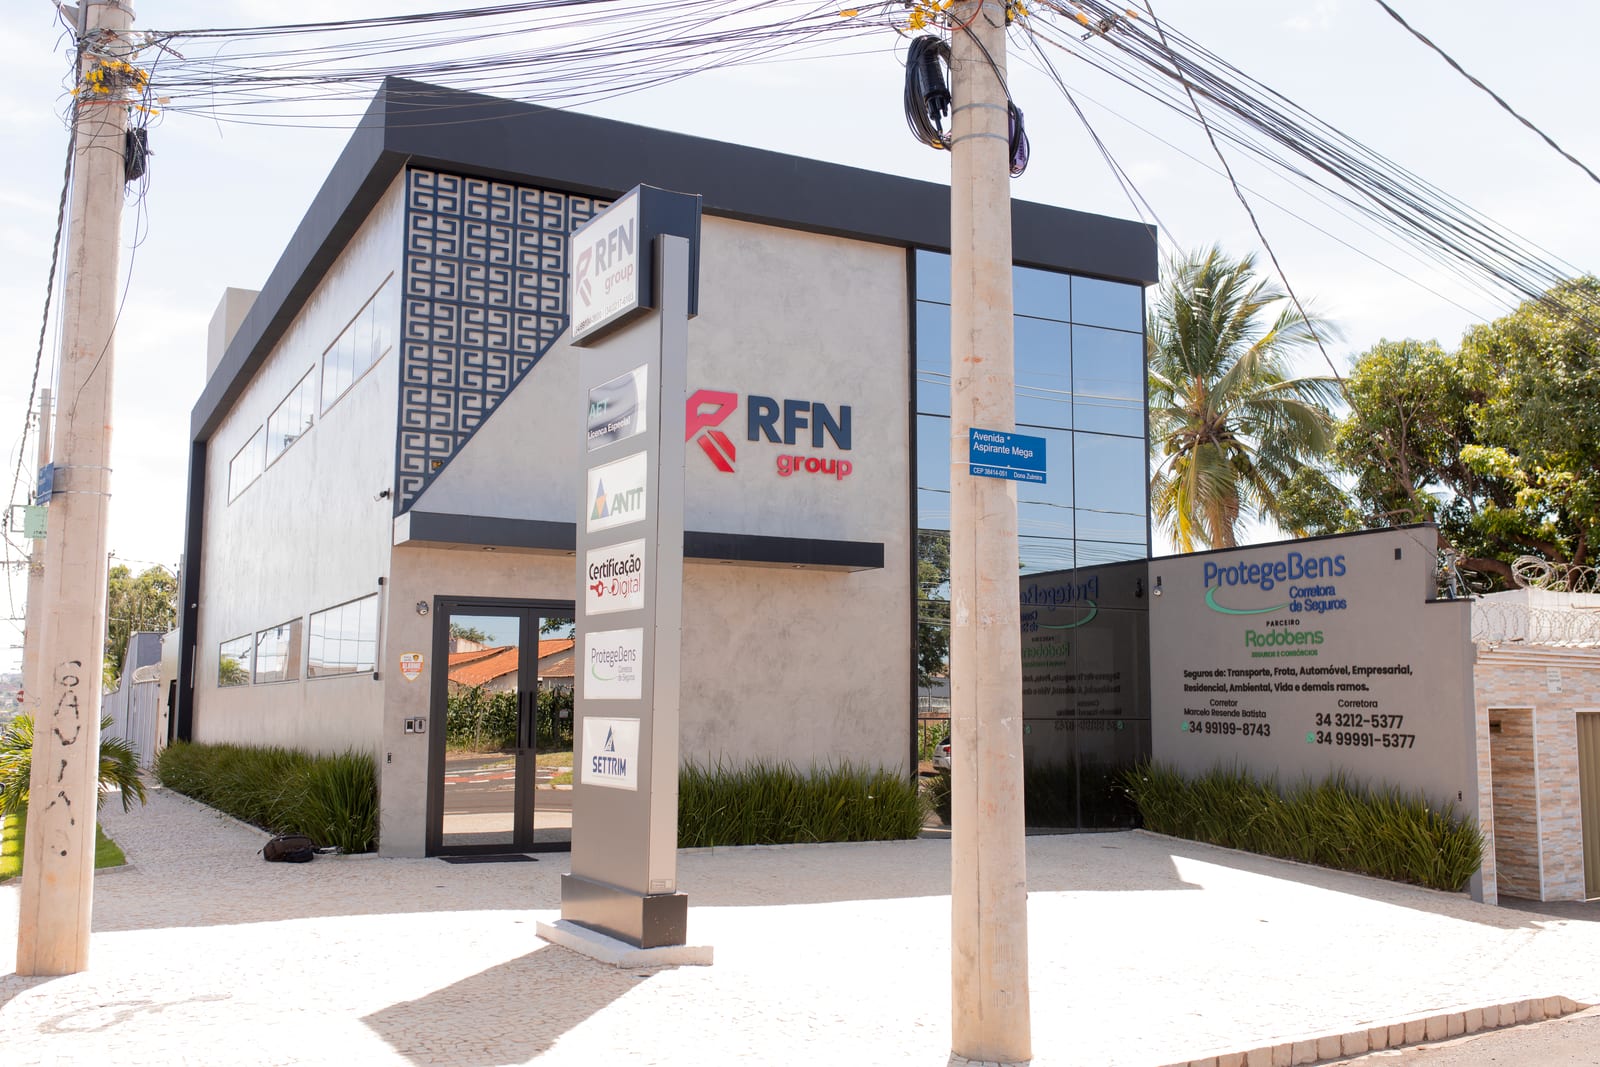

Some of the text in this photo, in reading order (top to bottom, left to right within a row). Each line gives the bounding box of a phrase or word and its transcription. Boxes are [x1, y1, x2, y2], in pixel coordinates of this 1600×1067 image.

[595, 217, 634, 277] RFN
[604, 263, 634, 295] group
[747, 395, 852, 451] RFN
[973, 431, 1005, 443] Avenida
[973, 442, 1033, 459] Aspirante Mega
[776, 453, 853, 480] group
[610, 486, 643, 516] ANTT
[589, 554, 641, 580] Certificação
[1203, 552, 1347, 591] ProtegeBens
[611, 573, 641, 598] Digital
[1289, 584, 1336, 599] Corretora
[1289, 598, 1347, 614] de Seguros
[1265, 619, 1301, 627] PARCEIRO
[1245, 628, 1325, 648] Rodobens
[591, 646, 636, 667] ProtegeBens
[1184, 664, 1413, 680] Seguros de: Transporte, Frota, Automóvel, Empresarial,
[1184, 681, 1370, 693] Residencial, Ambiental, Vida e demais ramos.
[1209, 698, 1238, 707] Corretor
[1338, 699, 1378, 708] Corretora
[1184, 707, 1267, 718] Marcelo Resende Batista
[1315, 713, 1403, 729] 34 3212-5377
[1189, 720, 1271, 737] 34 99199-8743
[1316, 730, 1416, 749] 34 99991-5377
[592, 755, 627, 776] SETTRIM
